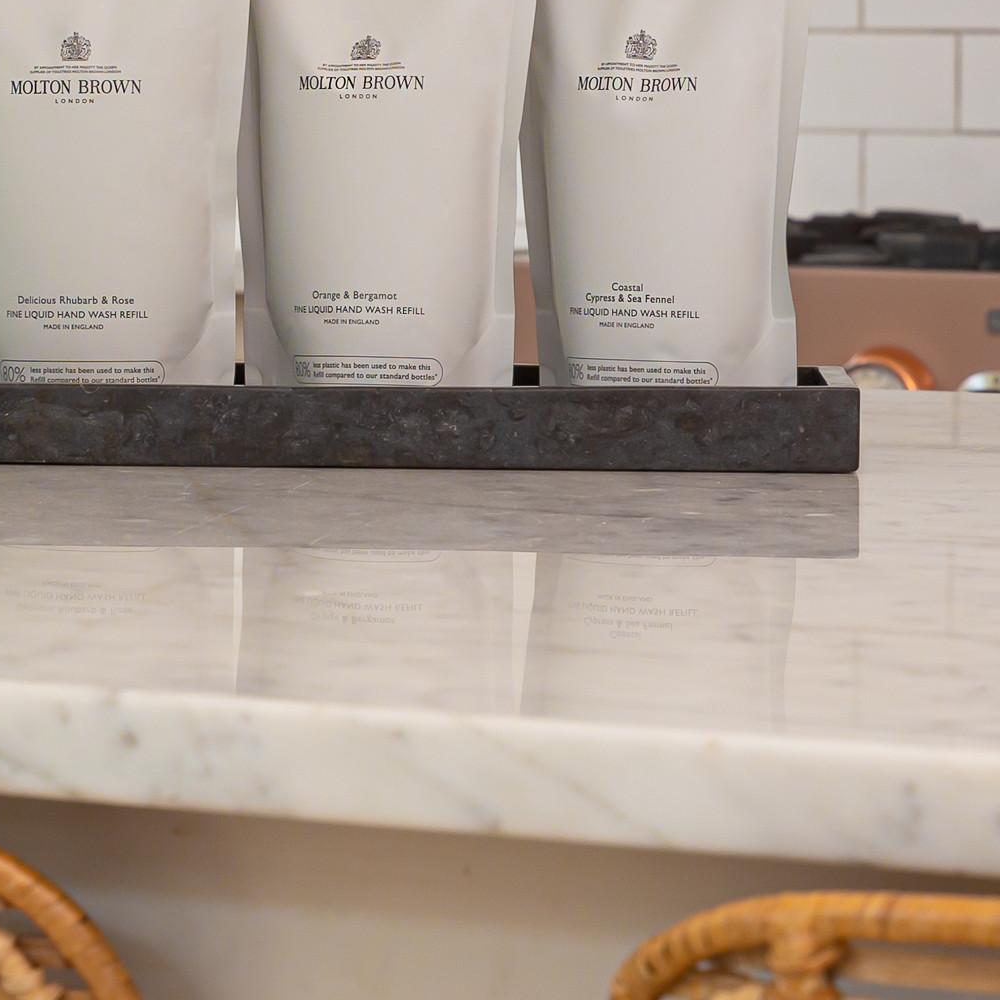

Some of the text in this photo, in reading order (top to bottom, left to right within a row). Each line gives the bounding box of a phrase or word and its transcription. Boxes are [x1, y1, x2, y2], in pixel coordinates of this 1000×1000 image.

[11, 80, 141, 94] MOLTON BROWN
[299, 75, 424, 90] MOLTON BROWN
[577, 76, 697, 92] MOLTON BROWN
[612, 282, 643, 292] Coastal
[18, 296, 134, 304] Delicious Rhubarb & Rose
[312, 291, 397, 302] Orange & Bergamot
[585, 293, 674, 304] Cypress & Sea Fennel
[24, 311, 54, 320] LIQUID
[120, 311, 148, 319] REFILL
[308, 306, 333, 314] LIQUID
[365, 306, 393, 314] WASH
[396, 307, 425, 315] REFILL
[570, 307, 700, 319] FINE LIQUID HAND WASH REFILL
[2, 366, 26, 382] 80%
[43, 367, 63, 375] plastic
[325, 371, 355, 379] compared
[379, 372, 409, 380] standard
[47, 376, 80, 384] compared
[600, 375, 631, 383] compared
[654, 376, 685, 384] standard
